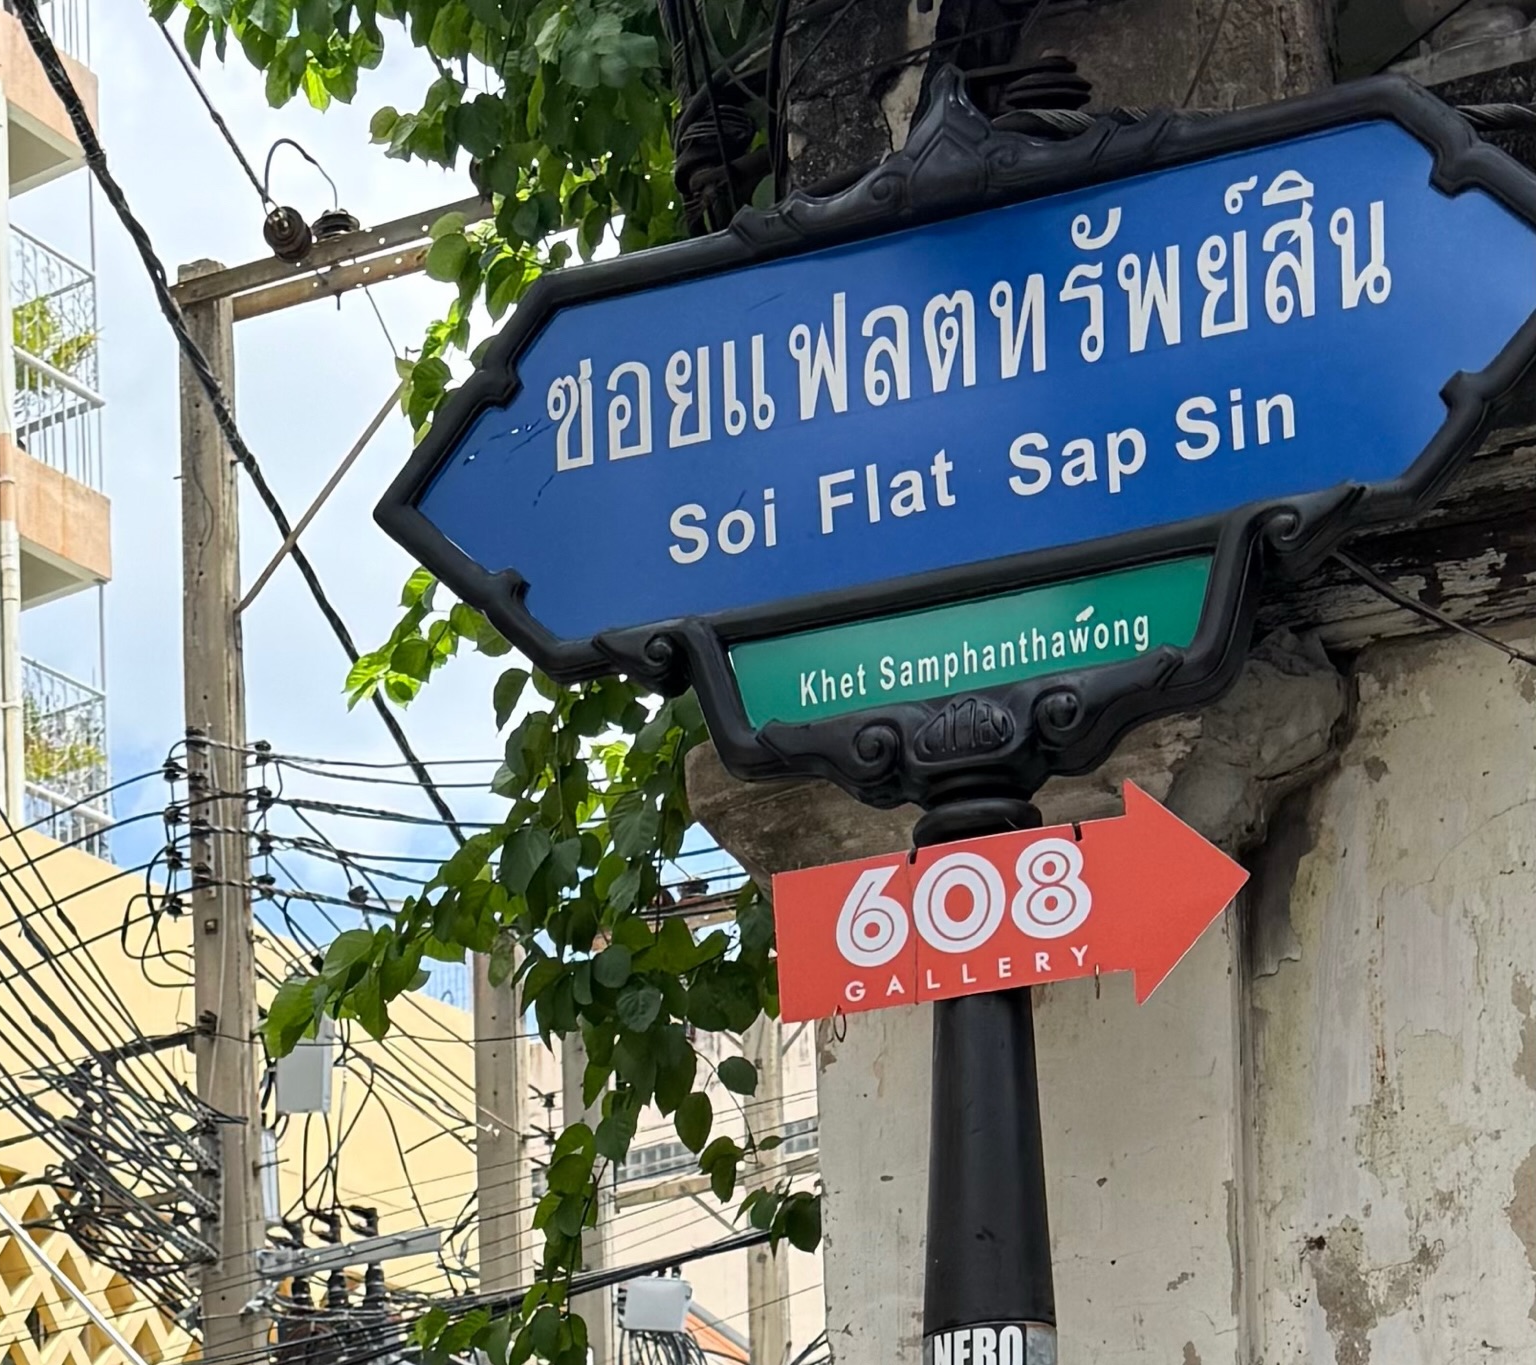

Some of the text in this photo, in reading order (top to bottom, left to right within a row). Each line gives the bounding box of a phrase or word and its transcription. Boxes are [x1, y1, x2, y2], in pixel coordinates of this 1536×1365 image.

[547, 169, 1392, 473] ซอยแฟลตทรัพย์สิน
[667, 386, 1297, 566] Soi Flat Sap Sin
[800, 614, 1149, 707] Khet Samphanthawong
[835, 837, 1093, 968] 608
[844, 944, 1089, 1002] GALLERY
